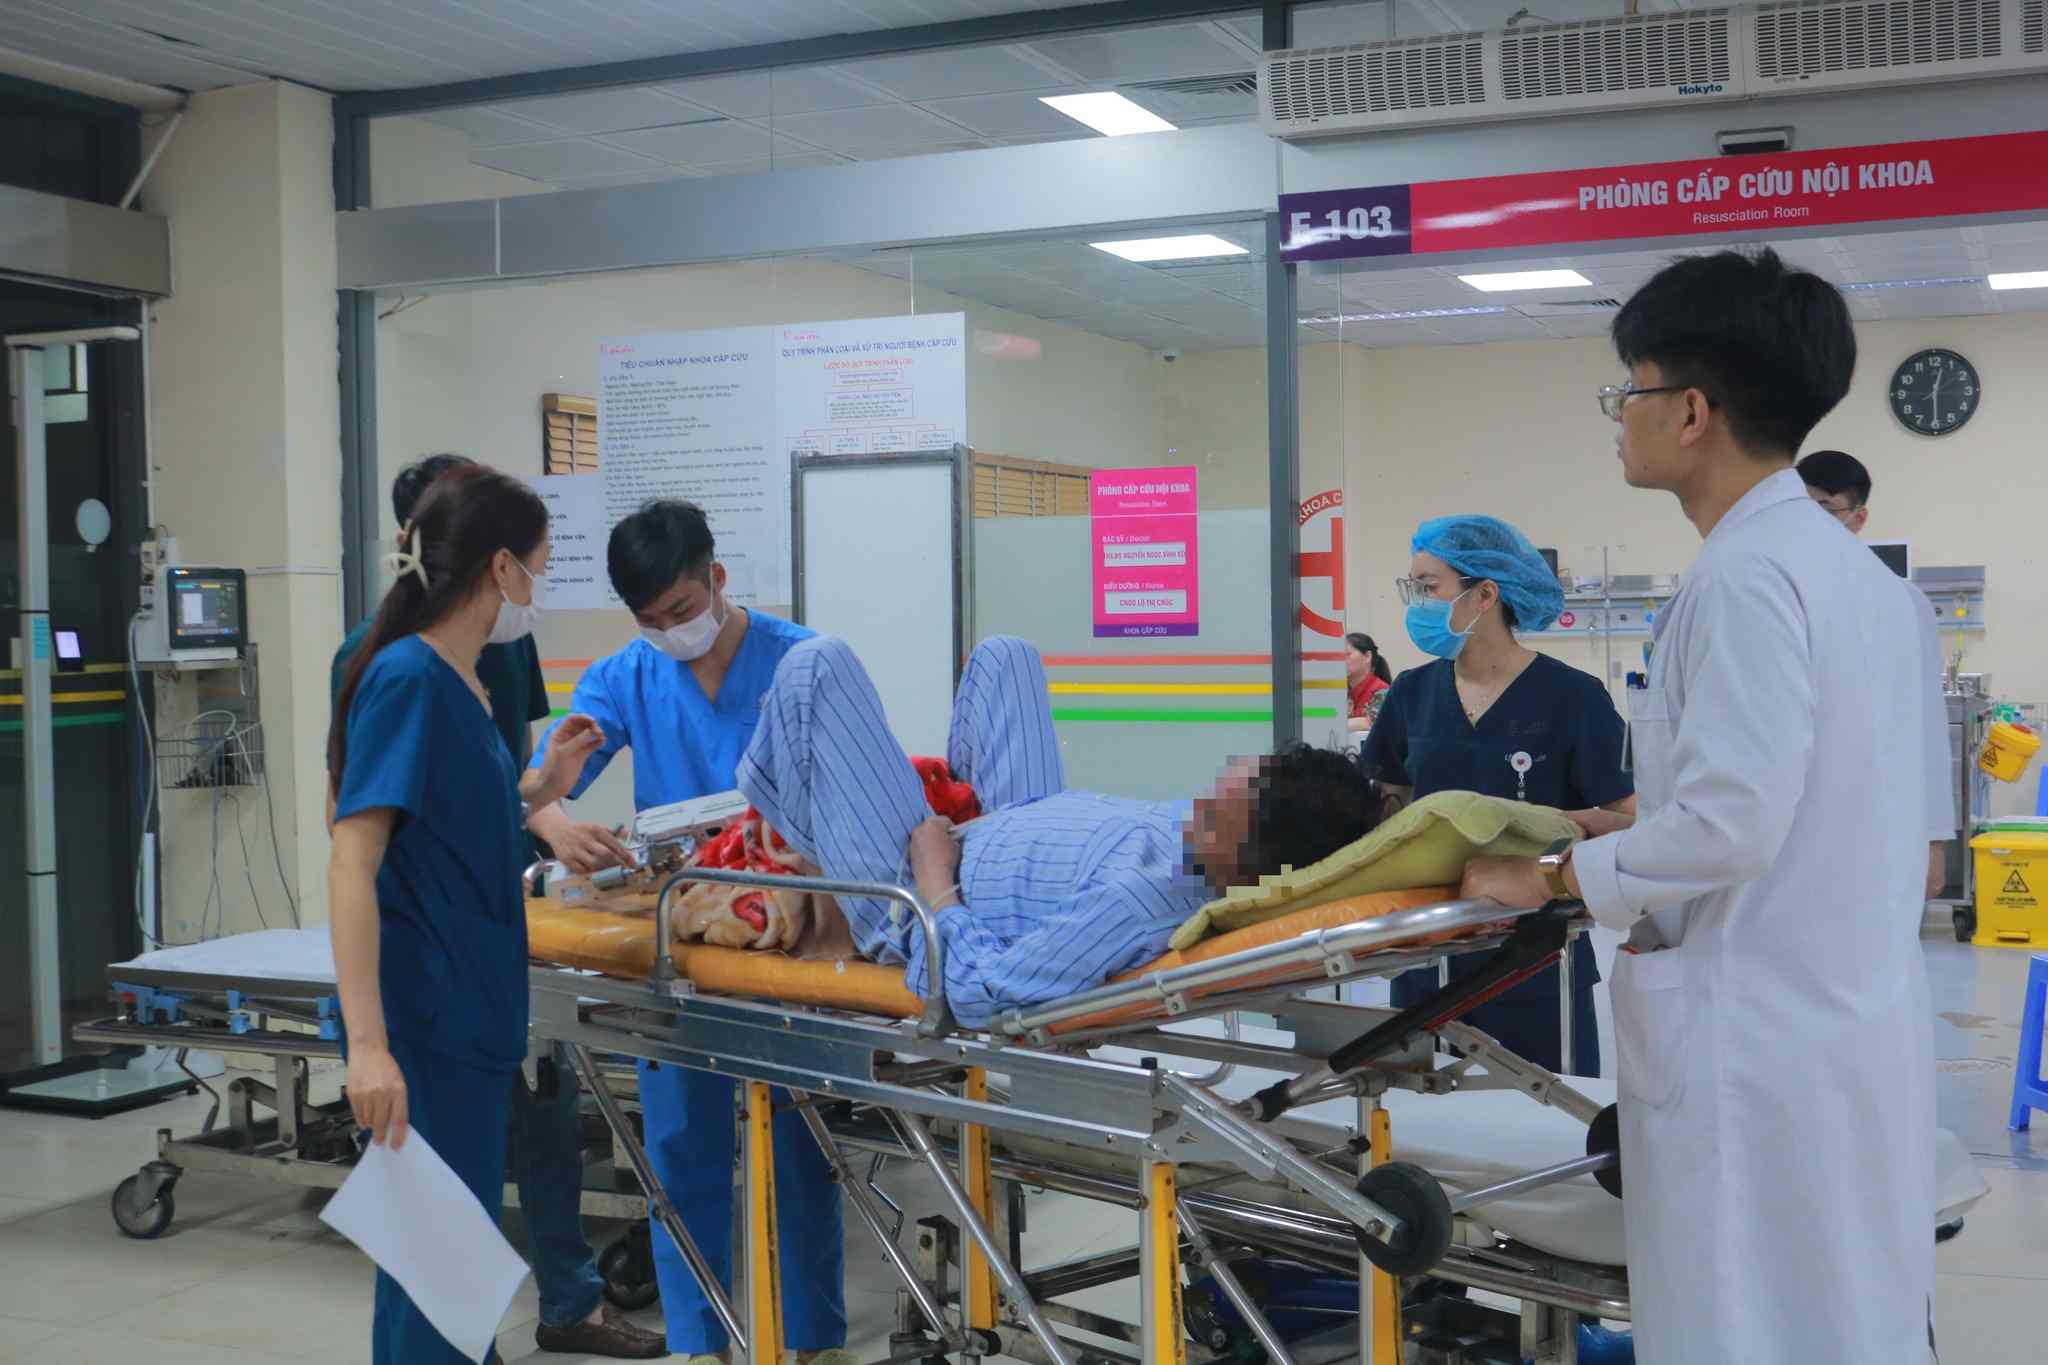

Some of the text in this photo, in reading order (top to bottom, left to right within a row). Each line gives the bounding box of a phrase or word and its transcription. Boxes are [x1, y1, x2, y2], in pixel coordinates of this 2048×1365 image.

[1679, 84, 1722, 95] Hokyto
[1578, 159, 1935, 211] PHÒNG CẤP CỨU NỘI KHOA
[1693, 206, 1810, 225] Resusciation Room
[1325, 206, 1392, 241] 103
[1928, 356, 1941, 367] 12
[1915, 362, 1923, 373] 11
[1901, 375, 1913, 385] 10
[1959, 370, 1968, 381] 2
[1897, 389, 1906, 400] 9
[1964, 385, 1973, 396] 3
[1903, 404, 1912, 415] 8
[1959, 400, 1968, 411] 4
[1915, 414, 1924, 425] 7
[1947, 412, 1956, 423] 5
[1930, 419, 1940, 429] 6
